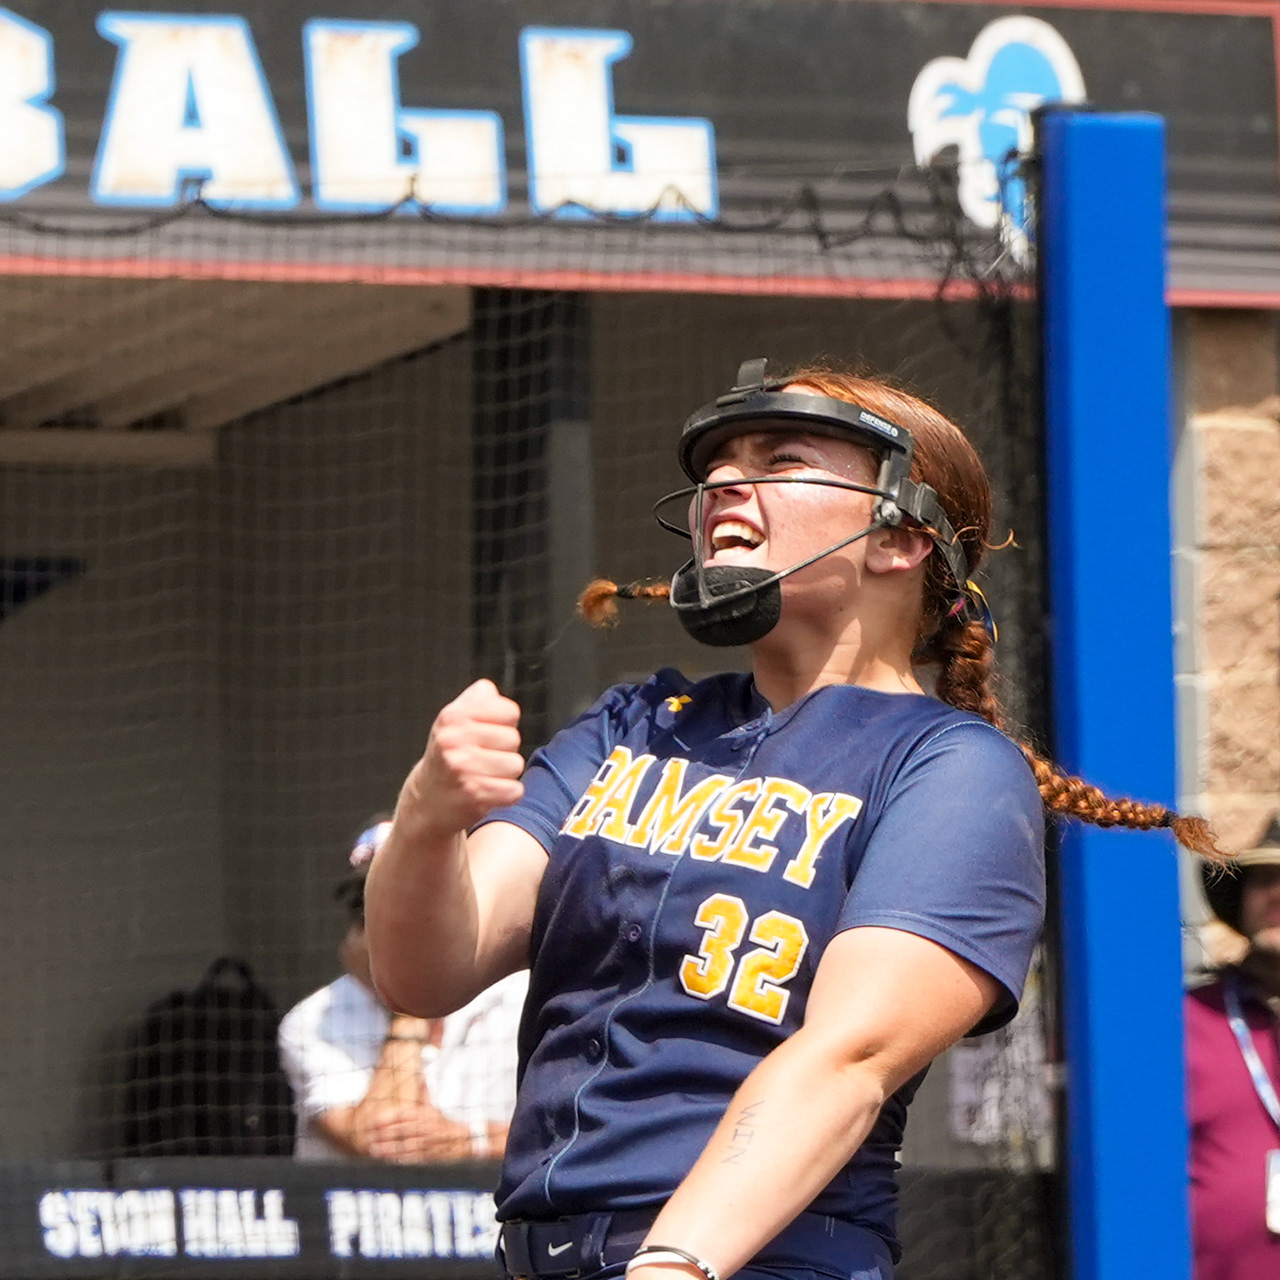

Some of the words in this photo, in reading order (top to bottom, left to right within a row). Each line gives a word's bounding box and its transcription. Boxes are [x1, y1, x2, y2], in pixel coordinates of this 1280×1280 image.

[558, 745, 864, 890] RAMSEY
[679, 893, 810, 1026] 32
[37, 1188, 178, 1258] SETON
[179, 1189, 301, 1258] HALL
